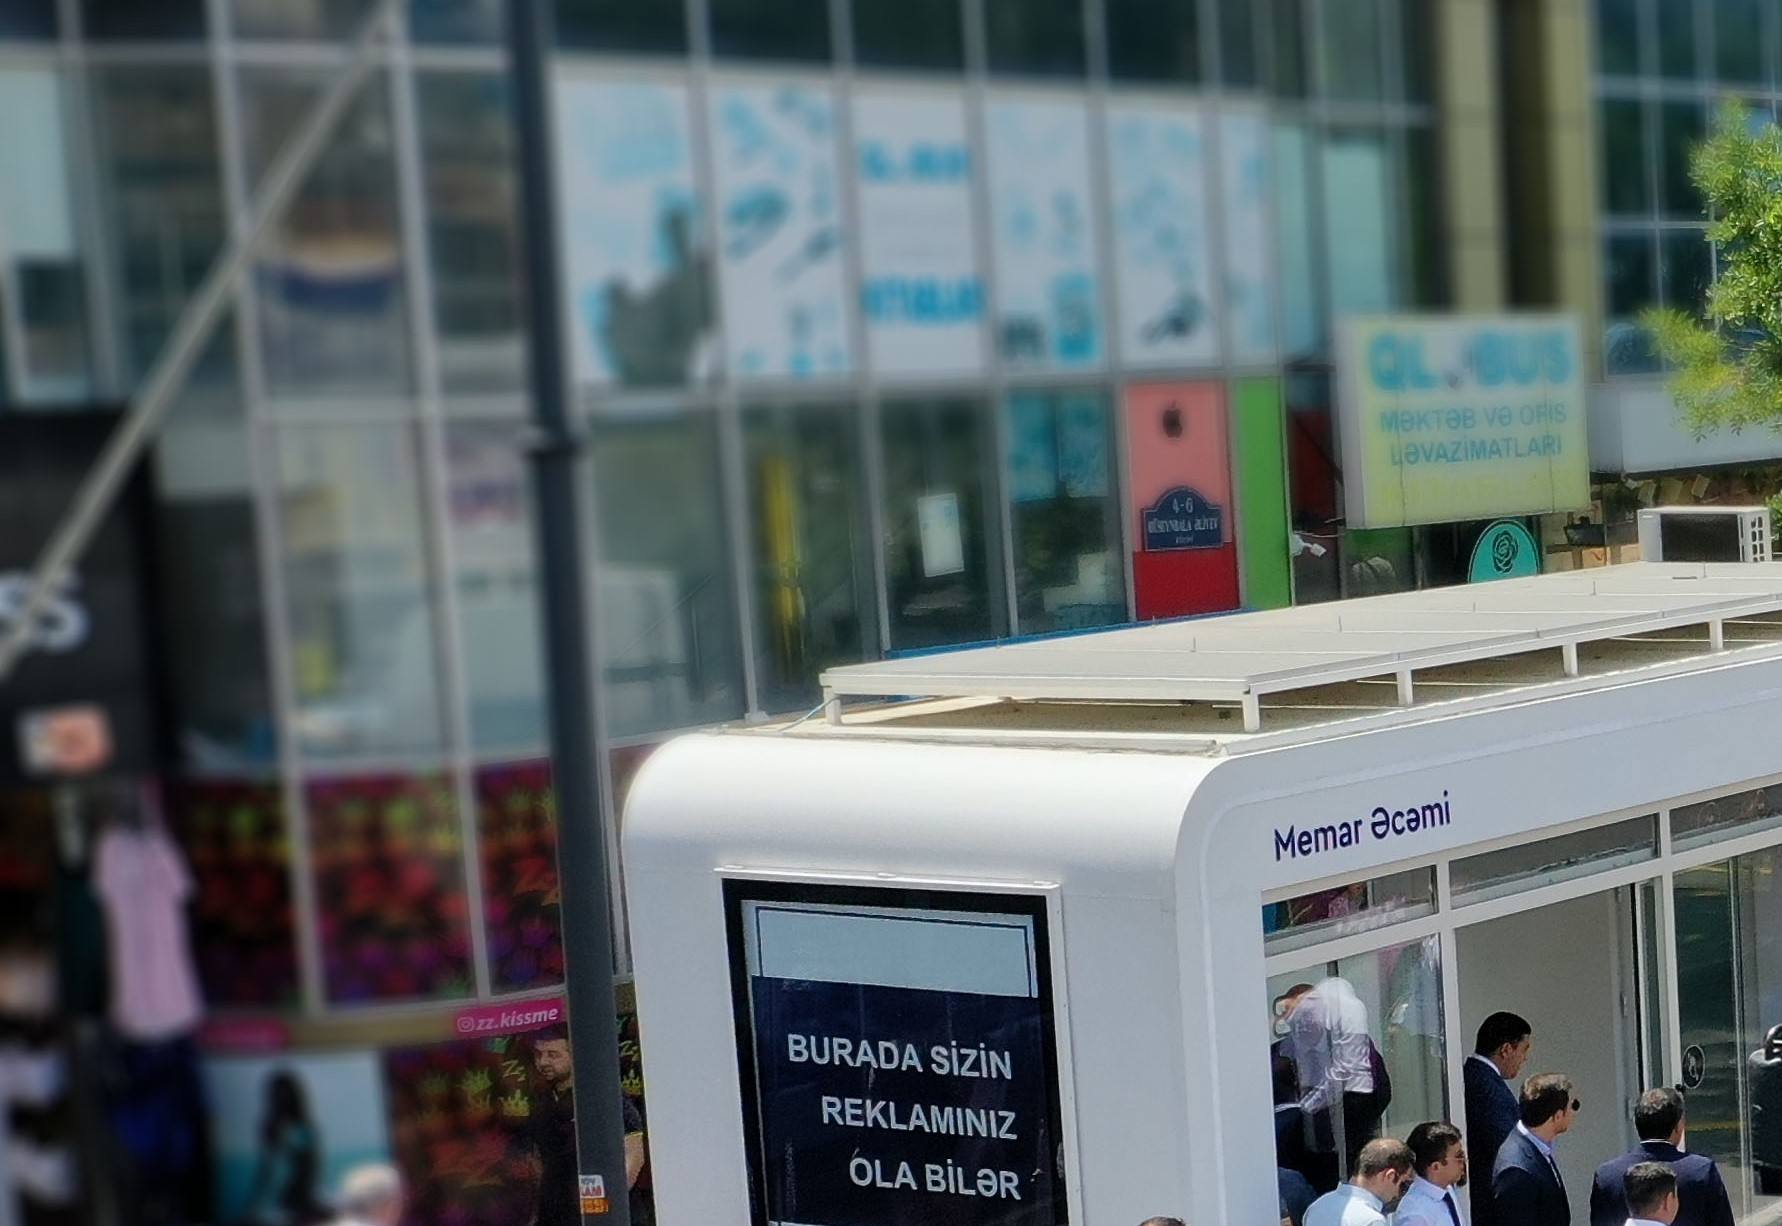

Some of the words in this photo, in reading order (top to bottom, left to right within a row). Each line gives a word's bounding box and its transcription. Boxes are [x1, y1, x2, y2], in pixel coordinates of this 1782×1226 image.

[1369, 331, 1573, 391] QLBUS
[1381, 407, 1477, 433] MƏKTƏB
[1483, 405, 1513, 428] VƏ
[1274, 819, 1363, 861] Memar
[1370, 790, 1451, 840] Əcəmi
[476, 1008, 558, 1031] zz.kissme
[788, 1033, 923, 1073] BURADA
[931, 1041, 1012, 1080] SİZİN
[822, 1095, 1018, 1140] REKLAMINIZ
[850, 1157, 918, 1191] OLA
[925, 1159, 1021, 1200] BİLƏR
